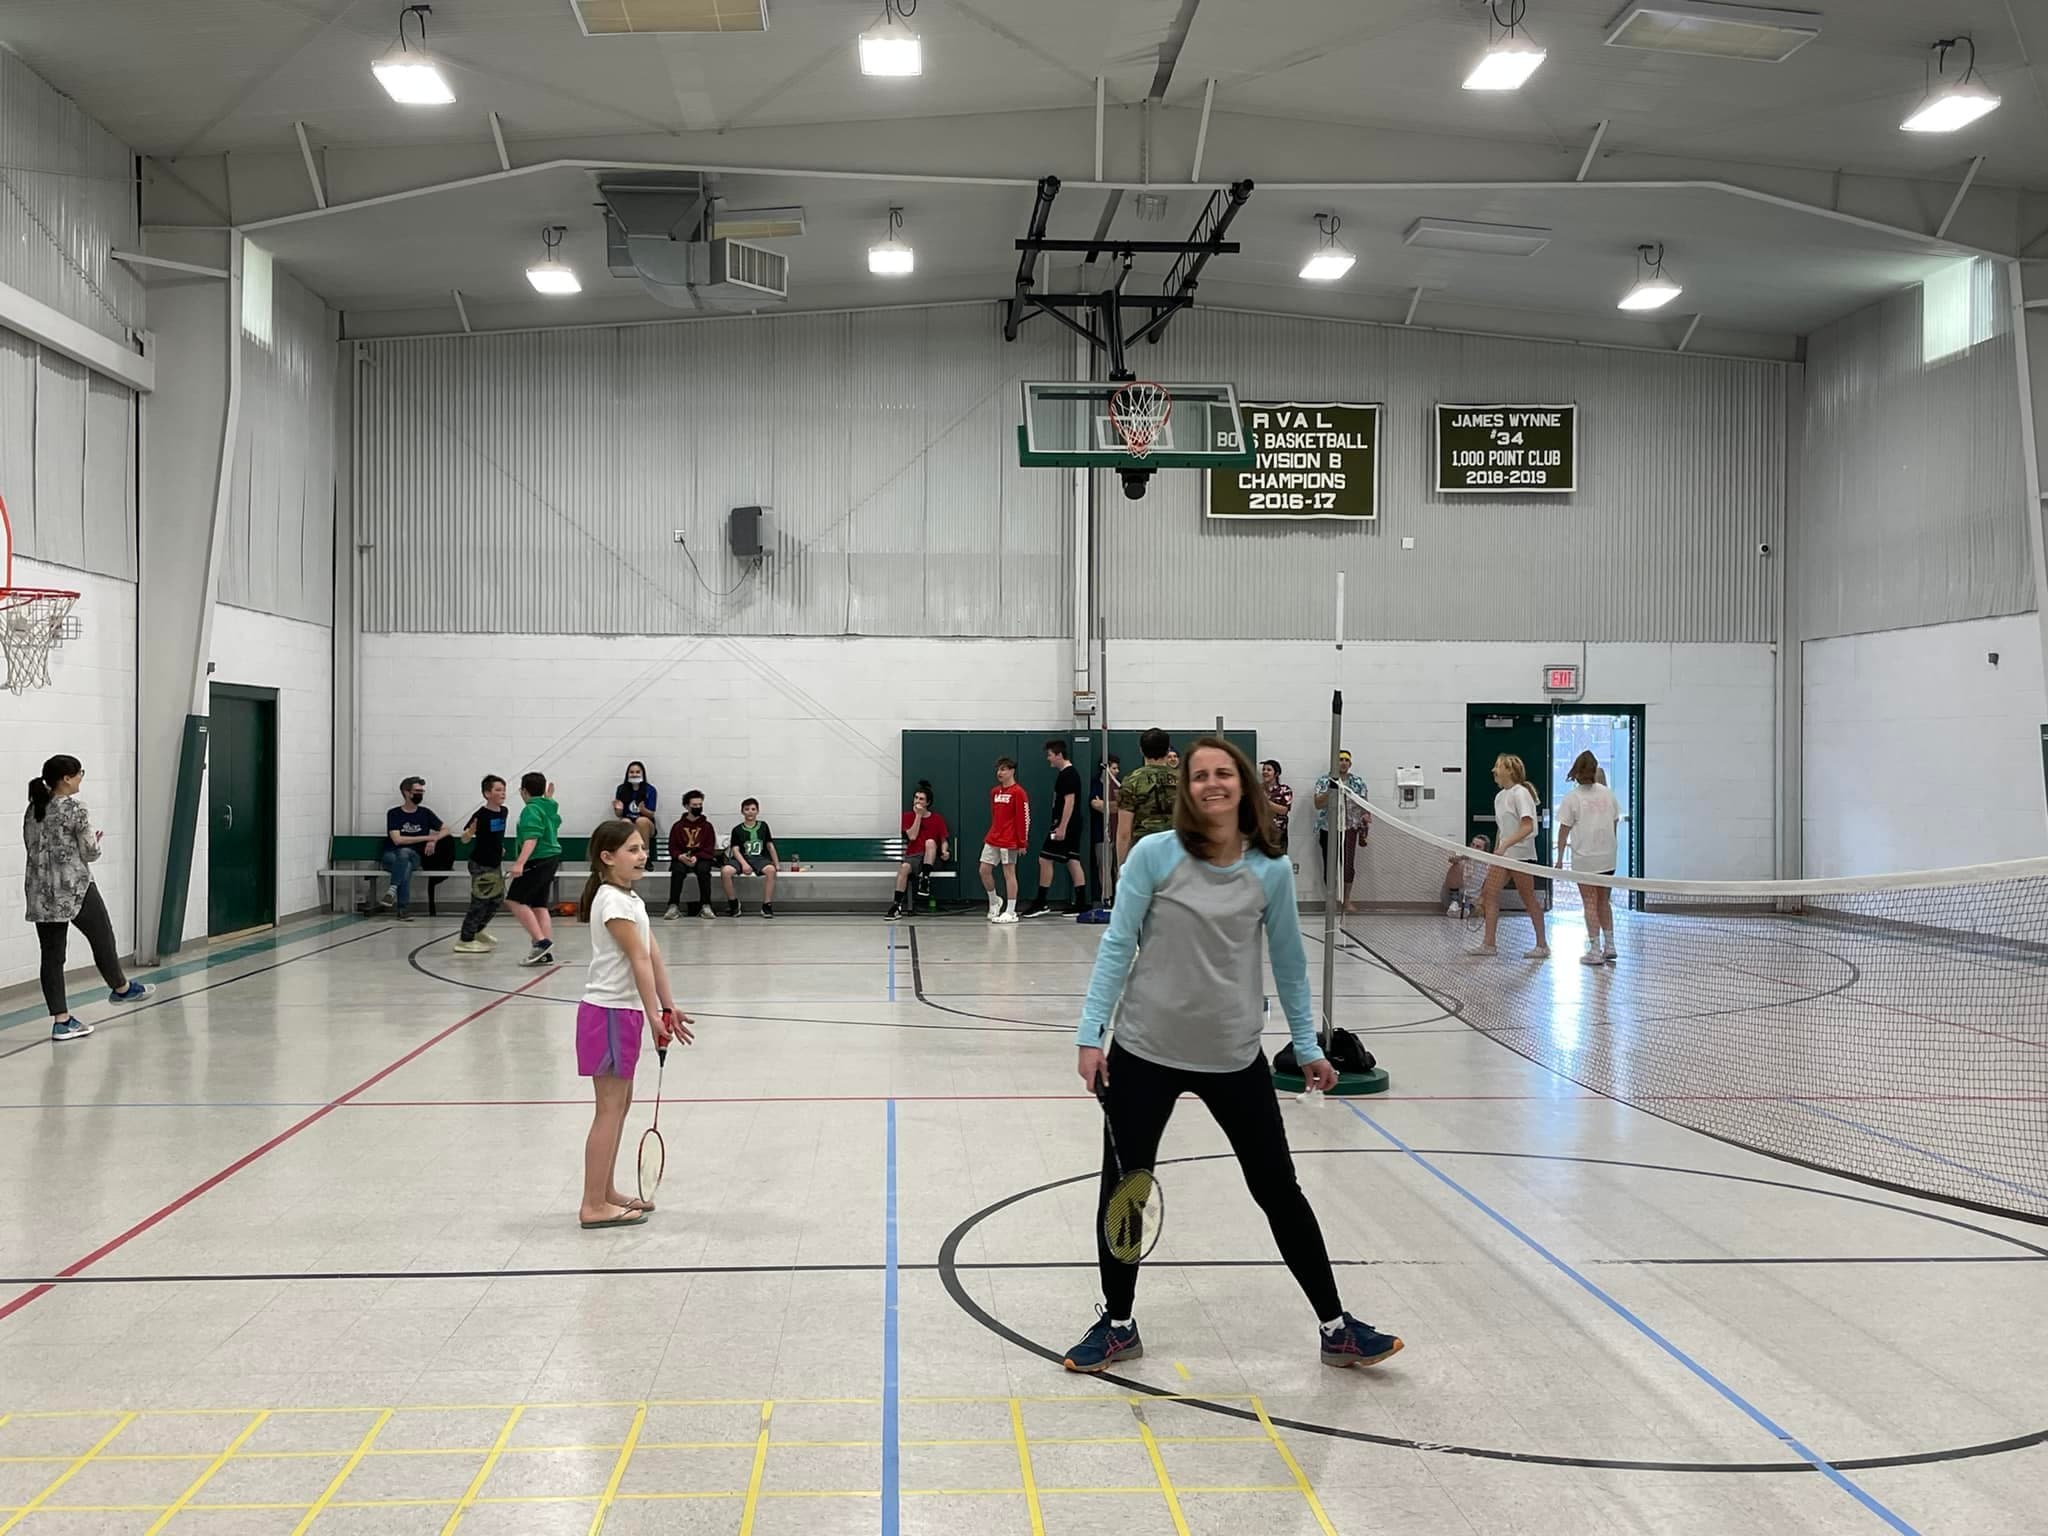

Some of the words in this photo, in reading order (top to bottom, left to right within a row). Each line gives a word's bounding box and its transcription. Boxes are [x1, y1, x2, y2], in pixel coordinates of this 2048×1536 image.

[1253, 412, 1332, 428] RVAL
[1452, 414, 1504, 427] JAMES
[1509, 414, 1561, 427] WYNNE
[1217, 432, 1258, 448] BOS
[1265, 433, 1368, 448] BASKETBALL
[1490, 429, 1524, 445] #34
[1256, 453, 1320, 468] IVISION
[1329, 454, 1341, 468] B
[1452, 451, 1484, 467] 1,000
[1489, 451, 1524, 466] POINT
[1528, 451, 1561, 466] CLUB
[1239, 473, 1346, 489] CHAMPIONS
[1466, 471, 1546, 484] 2018-2019
[1249, 493, 1336, 509] 2016-17
[1552, 671, 1572, 687] EXIT
